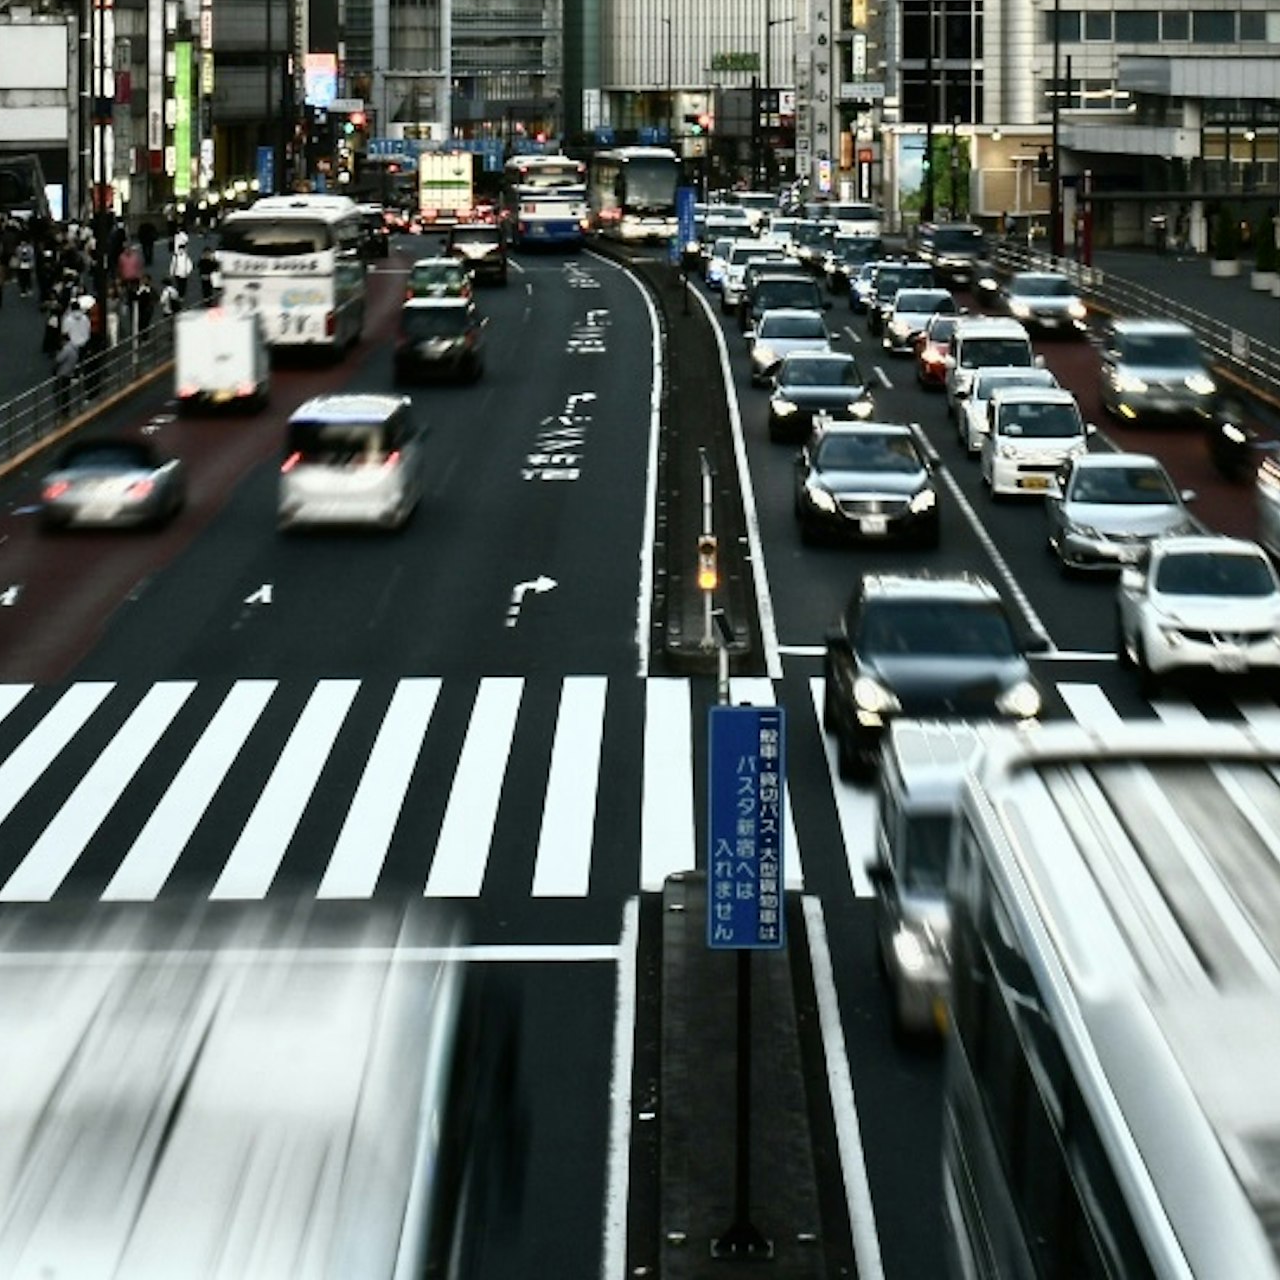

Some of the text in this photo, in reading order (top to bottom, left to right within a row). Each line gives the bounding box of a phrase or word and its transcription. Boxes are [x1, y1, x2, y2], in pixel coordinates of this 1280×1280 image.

[715, 838, 734, 940] 入れません
[736, 755, 756, 900] バスタ新宿へは
